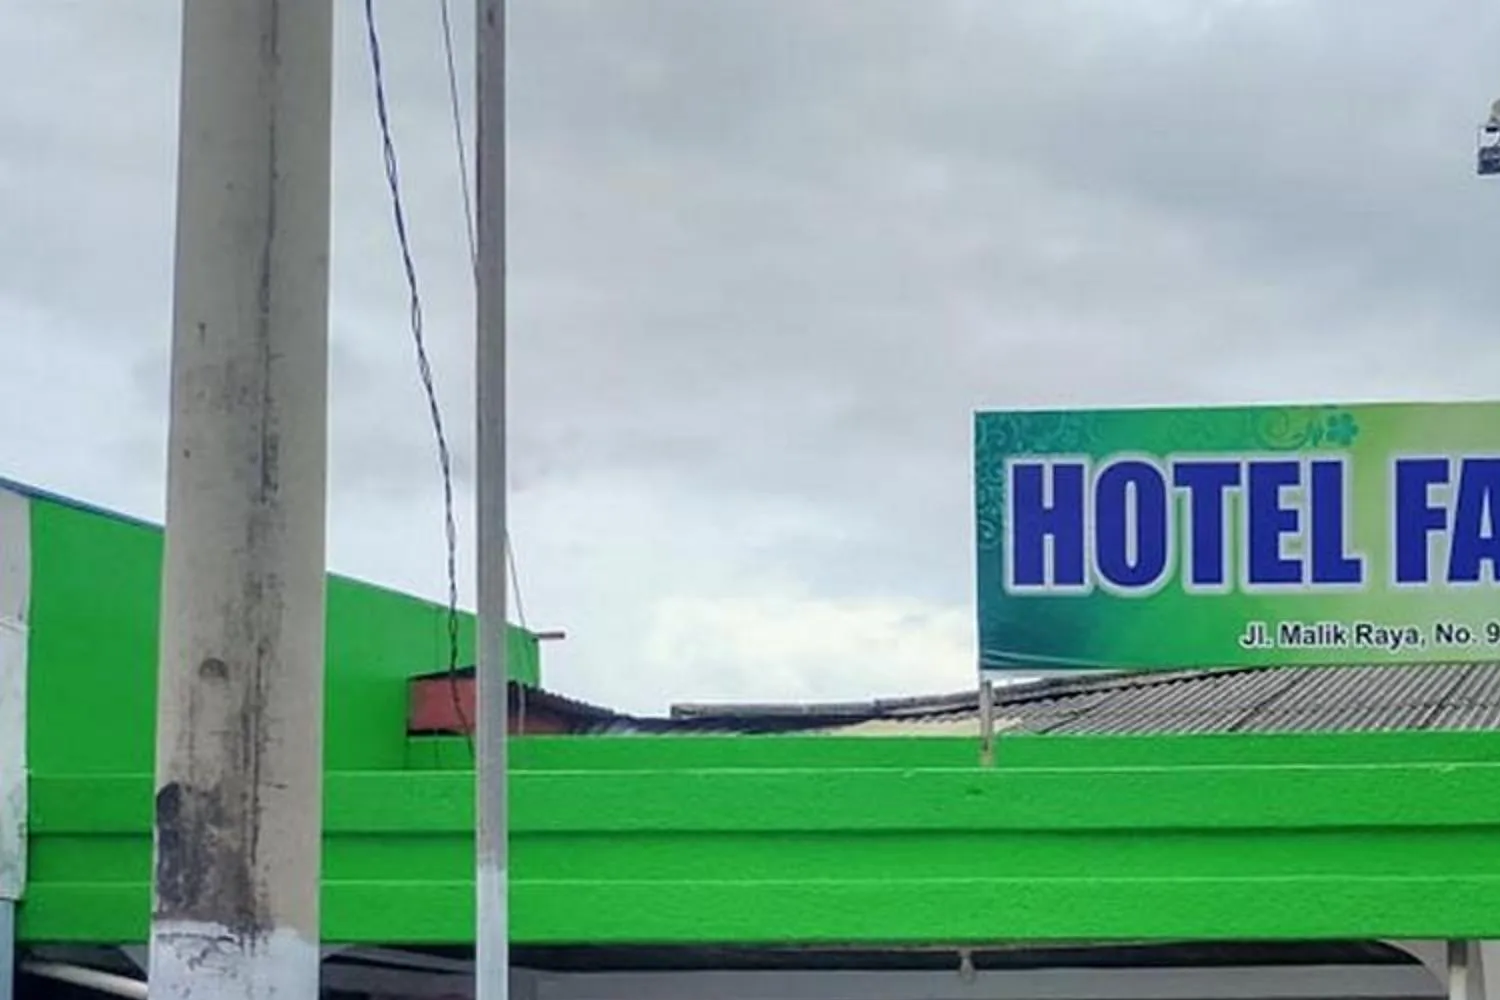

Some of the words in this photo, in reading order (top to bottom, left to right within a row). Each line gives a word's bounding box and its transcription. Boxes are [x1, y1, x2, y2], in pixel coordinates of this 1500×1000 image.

[1008, 456, 1366, 590] HOTEL
[1242, 623, 1272, 646] Jl.
[1279, 623, 1347, 646] Malik
[1354, 623, 1426, 649] Raya,
[1434, 622, 1477, 644] No.
[1486, 621, 1500, 643] 9
